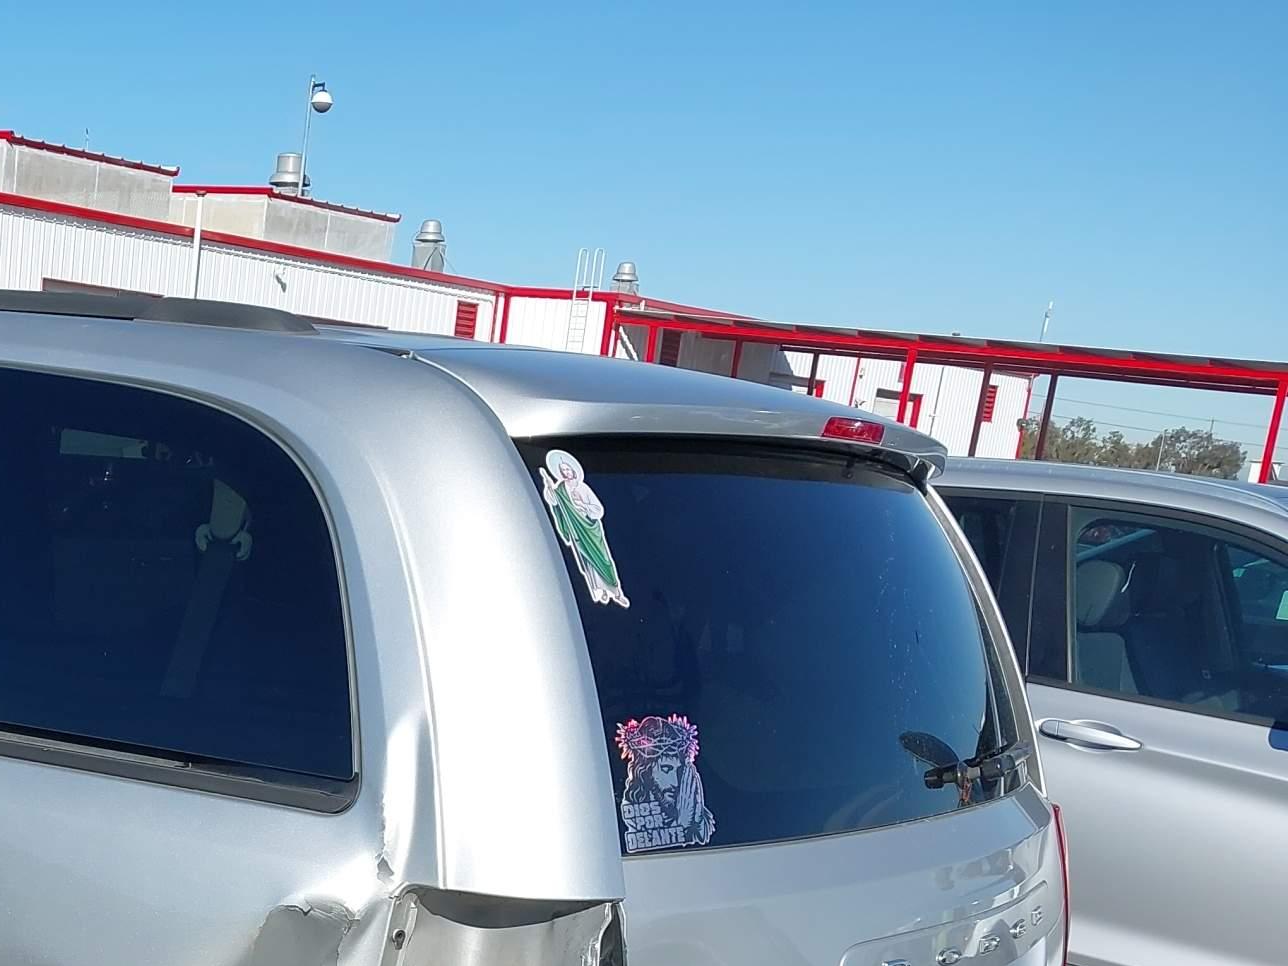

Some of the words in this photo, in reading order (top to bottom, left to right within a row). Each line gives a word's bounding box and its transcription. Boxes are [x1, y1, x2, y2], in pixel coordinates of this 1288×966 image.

[623, 801, 661, 819] DIOS
[635, 815, 664, 832] POR
[627, 826, 686, 850] DELANTE
